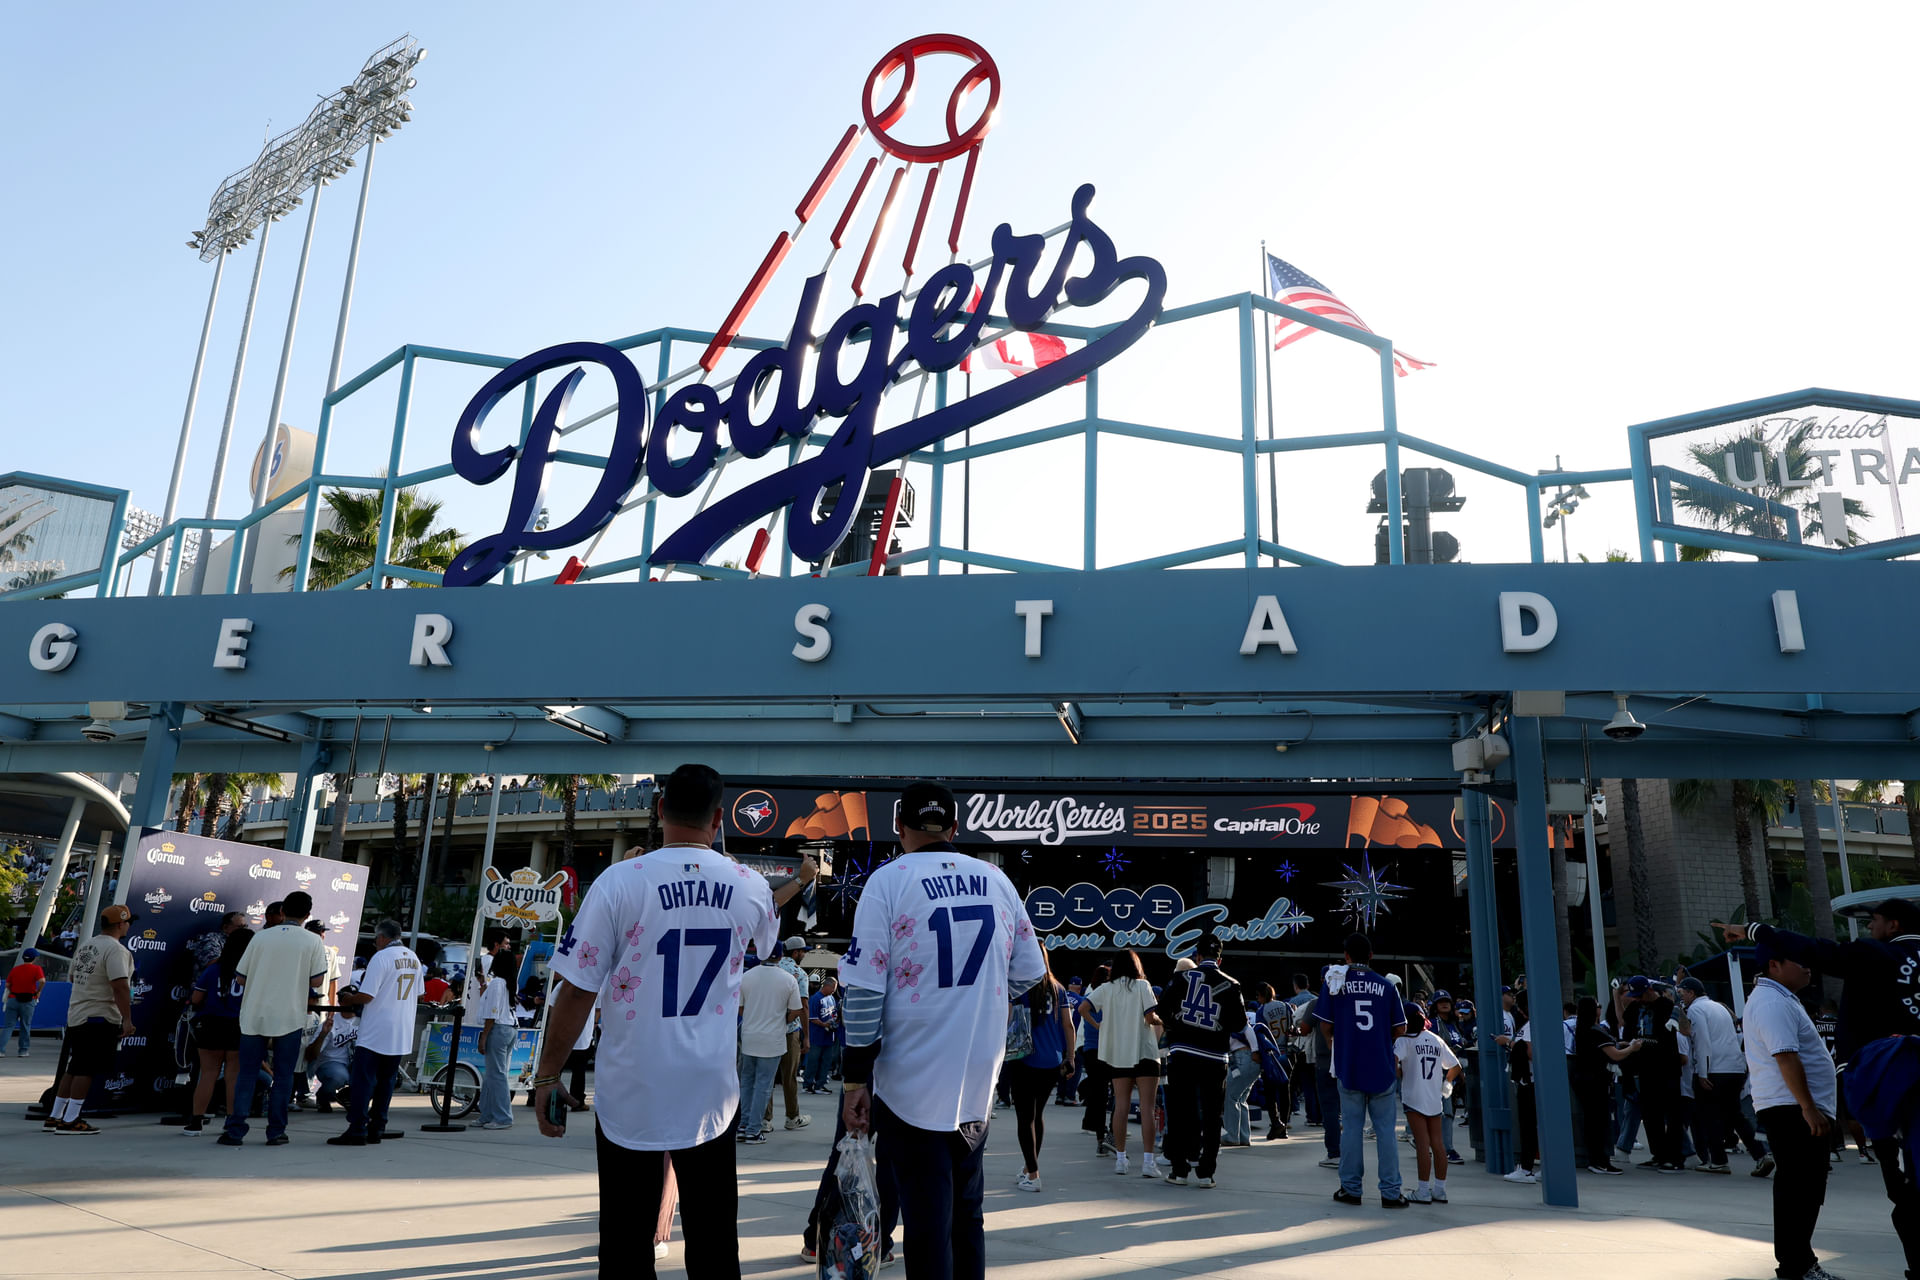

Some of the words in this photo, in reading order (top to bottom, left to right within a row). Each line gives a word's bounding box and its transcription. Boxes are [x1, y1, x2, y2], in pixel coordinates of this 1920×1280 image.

[442, 183, 1168, 588] Dodgers
[1751, 414, 1889, 444] Michelob
[1725, 447, 1920, 489] ULTRA
[1132, 812, 1208, 831] 2025
[147, 848, 185, 865] Corona
[248, 864, 281, 880] Corona
[331, 878, 359, 892] Corona
[486, 881, 556, 906] Corona
[657, 880, 734, 911] OHTANI
[921, 874, 988, 900] OHTANI
[189, 897, 226, 914] Corona
[1034, 896, 1173, 920] BLUE
[1112, 929, 1156, 948] on
[1165, 897, 1315, 960] Earth
[127, 935, 168, 952] Corona
[928, 904, 996, 989] 17
[656, 928, 732, 1018] 17
[1896, 956, 1917, 985] LOS
[397, 973, 416, 1001] 17
[1341, 980, 1385, 997] FREEMAN
[1181, 970, 1222, 1031] LA
[1354, 999, 1374, 1031] 5
[1269, 1017, 1287, 1039] 50
[1415, 1043, 1441, 1057] OHTANI
[1420, 1056, 1437, 1080] 17
